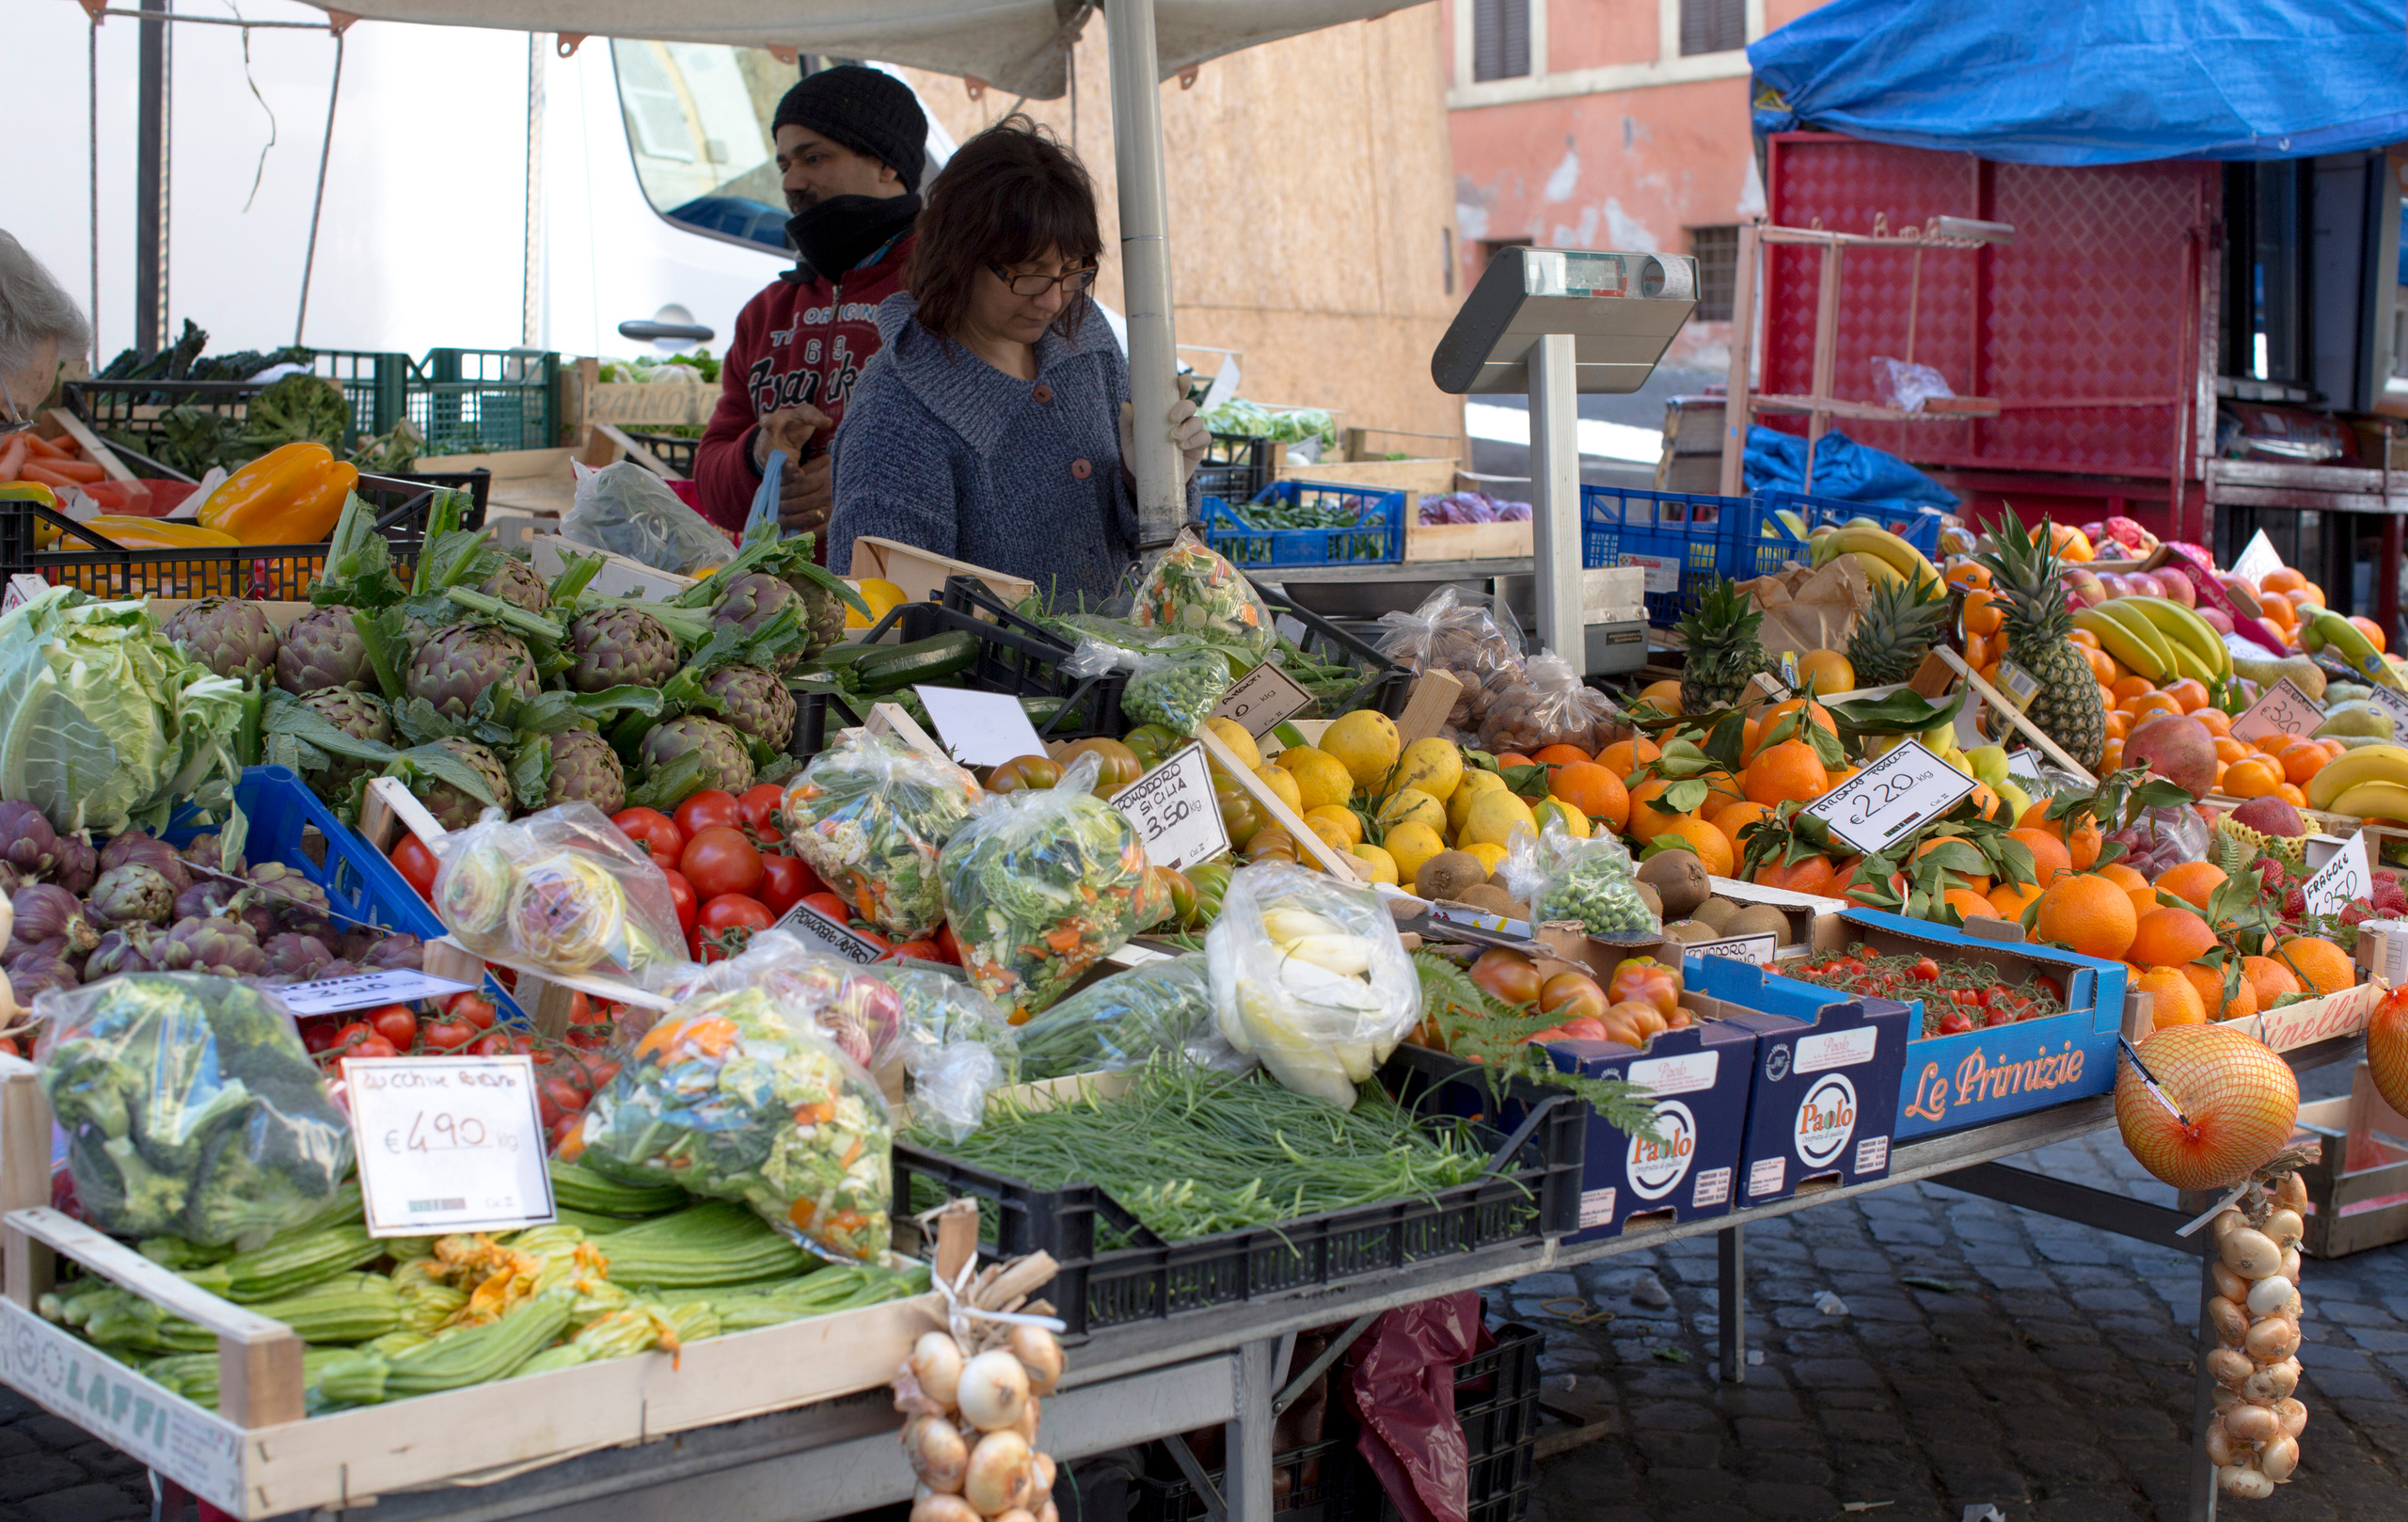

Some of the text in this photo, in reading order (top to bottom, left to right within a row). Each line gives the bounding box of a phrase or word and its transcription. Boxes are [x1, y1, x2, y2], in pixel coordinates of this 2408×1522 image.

[803, 302, 879, 325] ORIGIN
[1117, 763, 1181, 811] POMODORO
[1823, 1036, 1848, 1054] Paolo
[1658, 1060, 1687, 1078] Paolo
[1905, 1062, 1948, 1121] Le
[1954, 1040, 2084, 1106] Primizie
[1799, 1099, 1853, 1134] Paolo
[1631, 1127, 1692, 1165] Paolo
